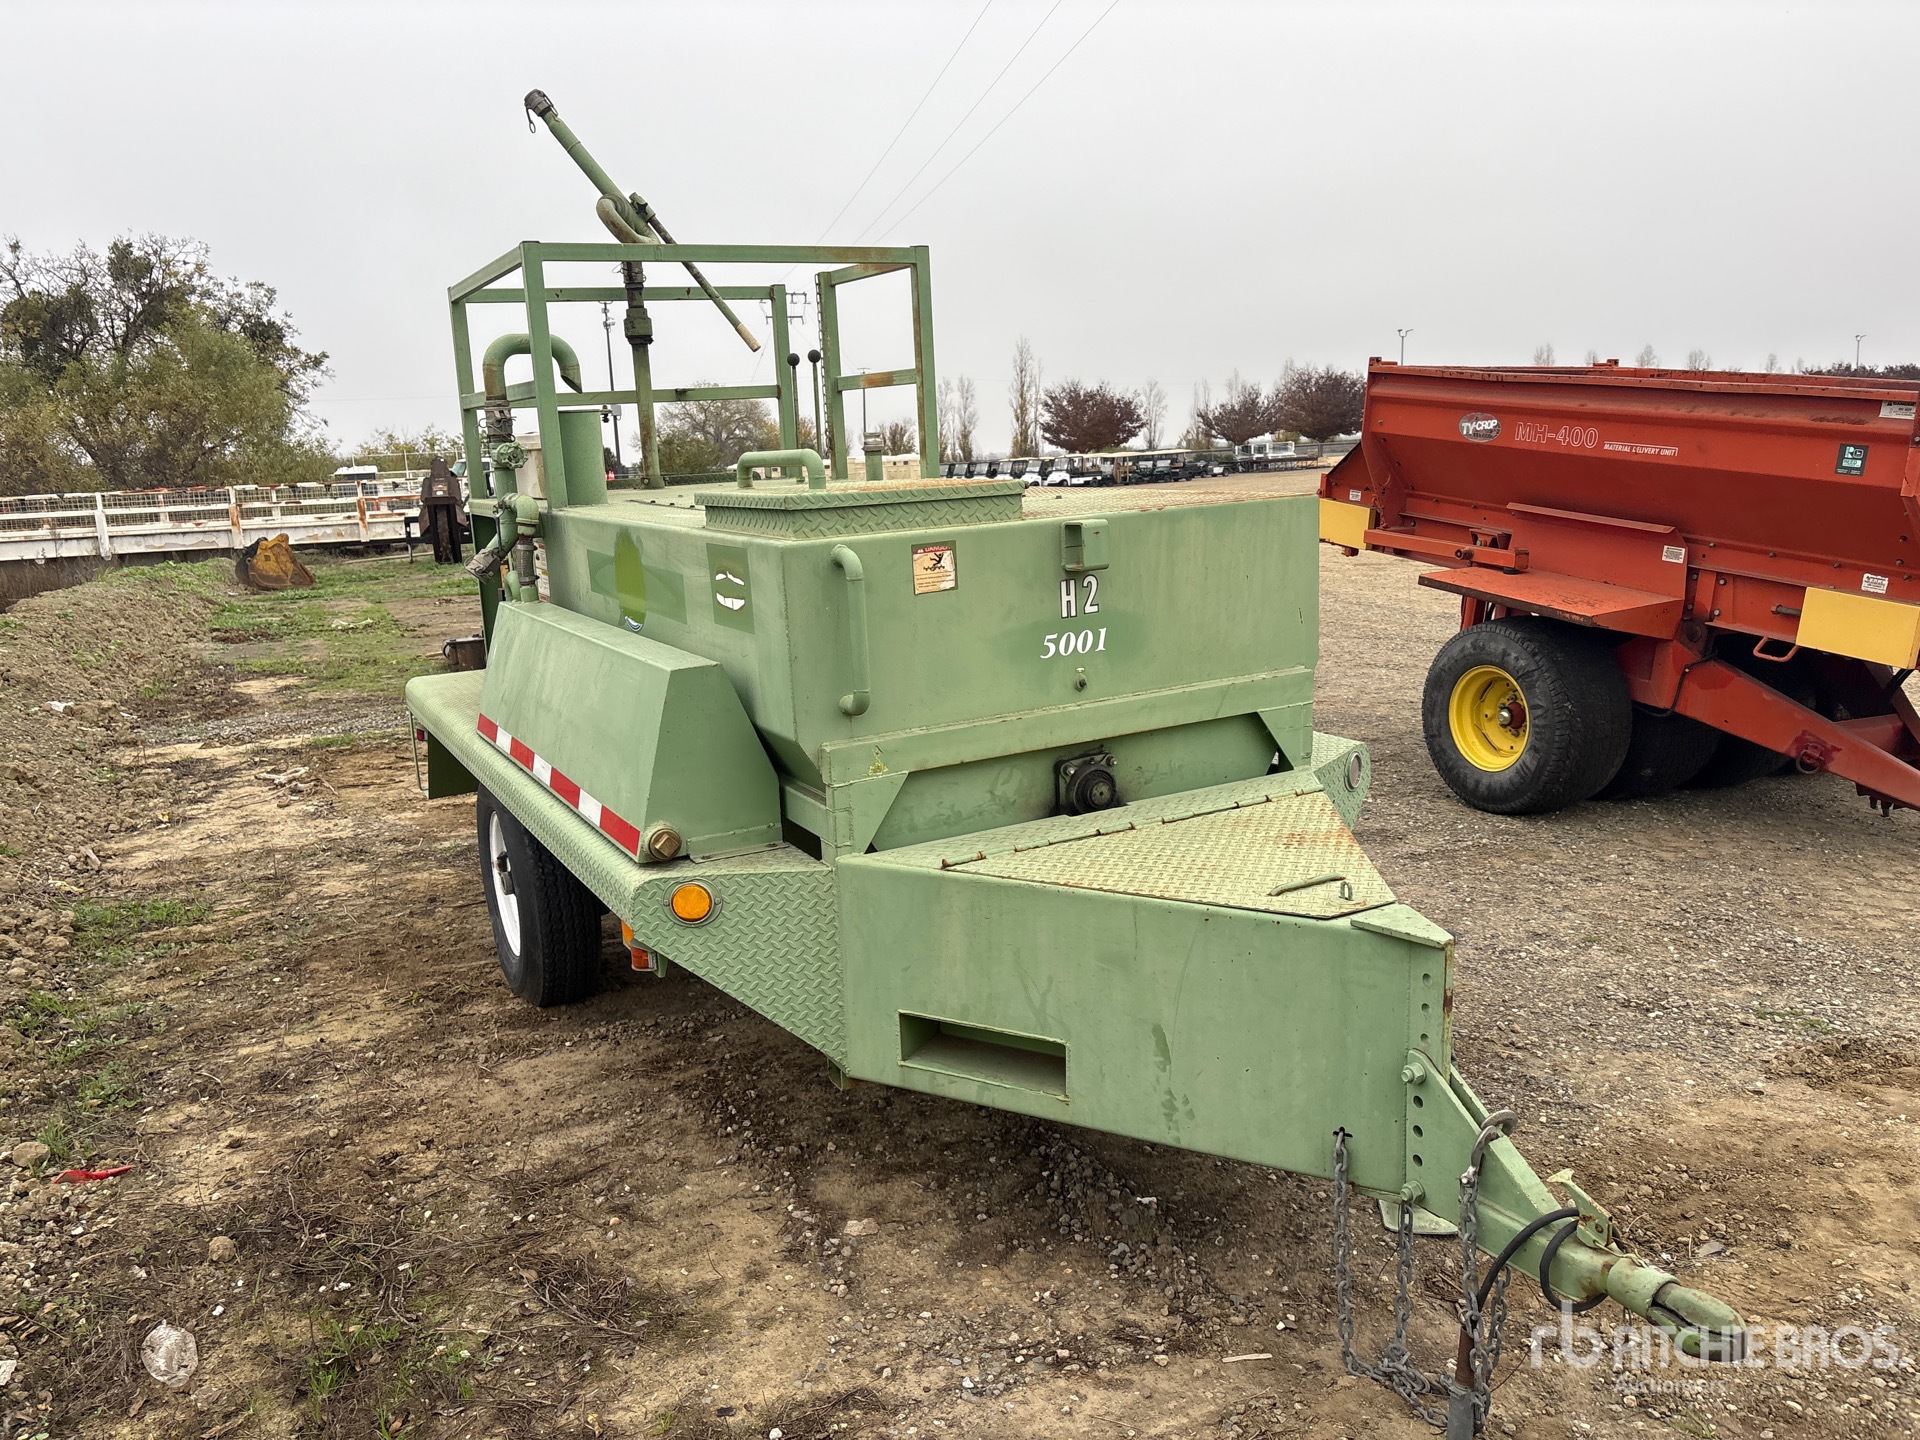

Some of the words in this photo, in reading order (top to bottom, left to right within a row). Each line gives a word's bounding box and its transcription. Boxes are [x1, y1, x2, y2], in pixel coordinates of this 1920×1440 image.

[1461, 419, 1498, 435] TY-CROP
[1515, 421, 1599, 449] MH-400
[1603, 443, 1631, 452] MATERIAL
[1660, 448, 1676, 456] UNIT
[1040, 627, 1107, 659] 5001
